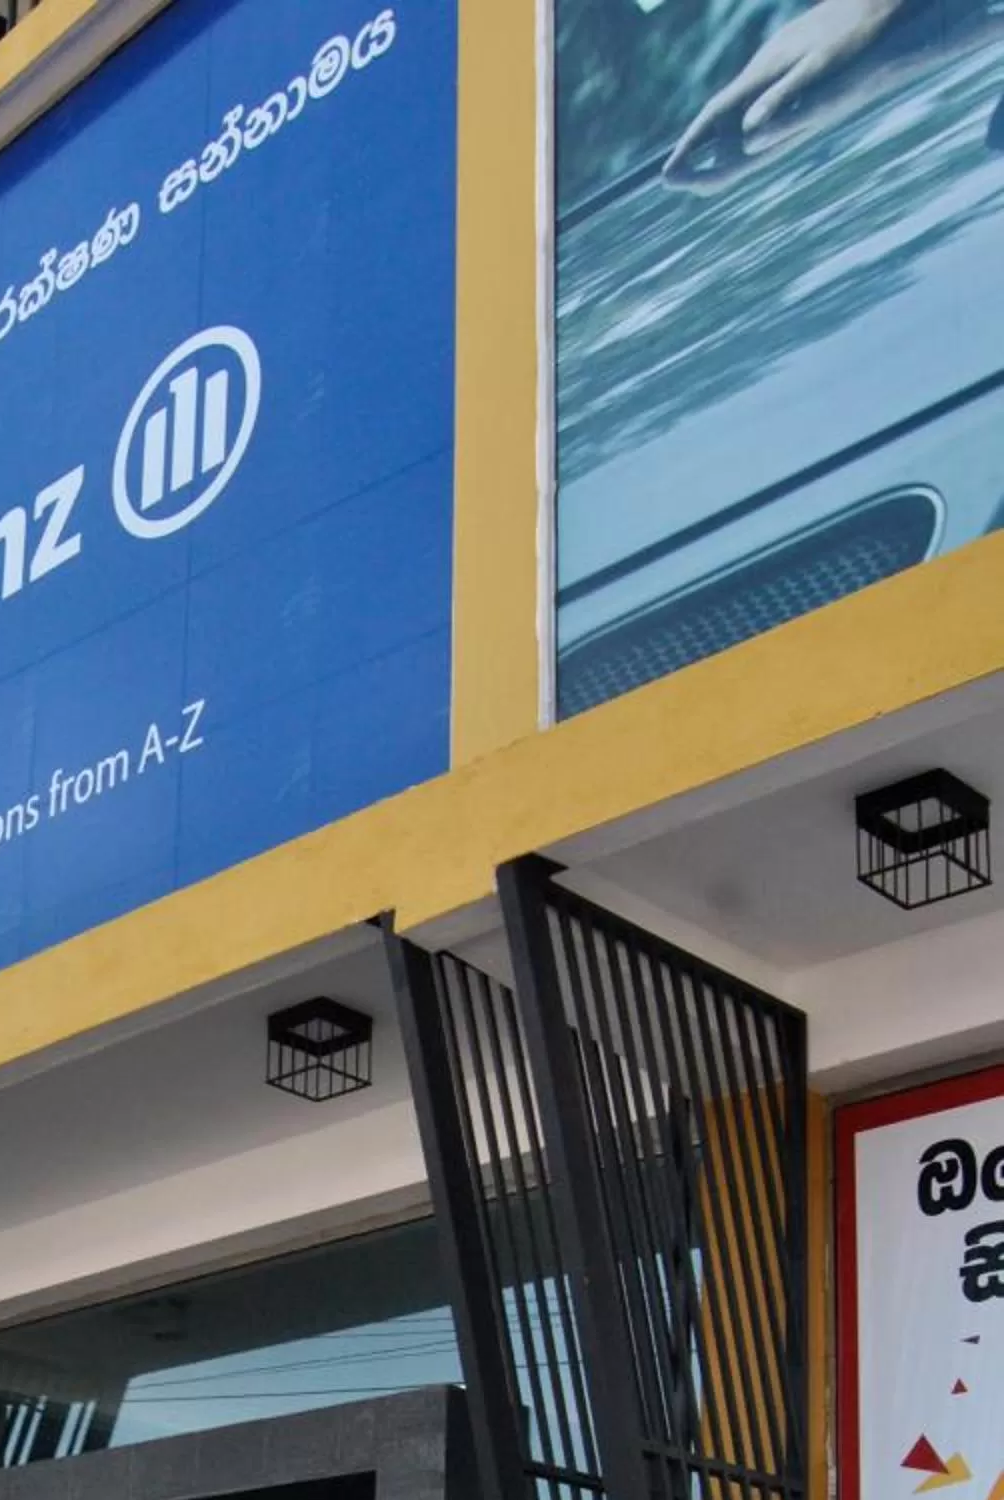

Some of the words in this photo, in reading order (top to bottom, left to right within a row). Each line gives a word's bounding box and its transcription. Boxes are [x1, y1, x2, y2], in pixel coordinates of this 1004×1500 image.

[158, 8, 396, 213] සන්නාමය
[48, 748, 129, 817] from
[137, 699, 205, 775] A-Z
